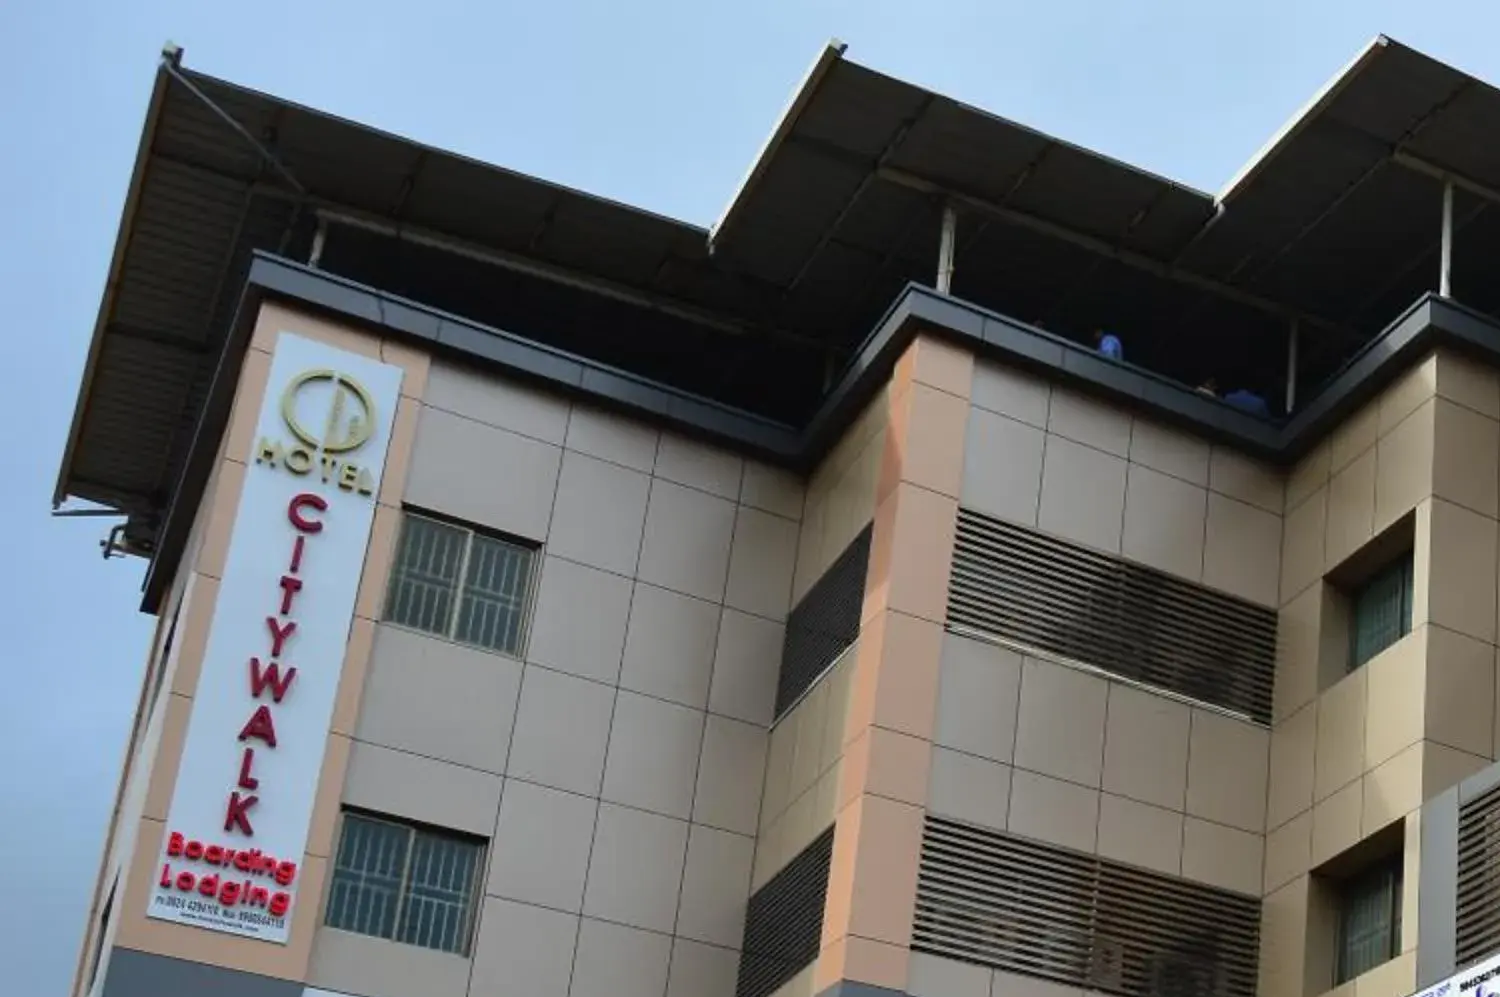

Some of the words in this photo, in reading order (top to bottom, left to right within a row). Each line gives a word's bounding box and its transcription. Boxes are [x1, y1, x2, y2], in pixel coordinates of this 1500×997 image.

[256, 437, 373, 497] HOTEL
[224, 492, 328, 838] CITYWALK
[167, 831, 297, 886] Boarding
[159, 863, 291, 917] Lodging
